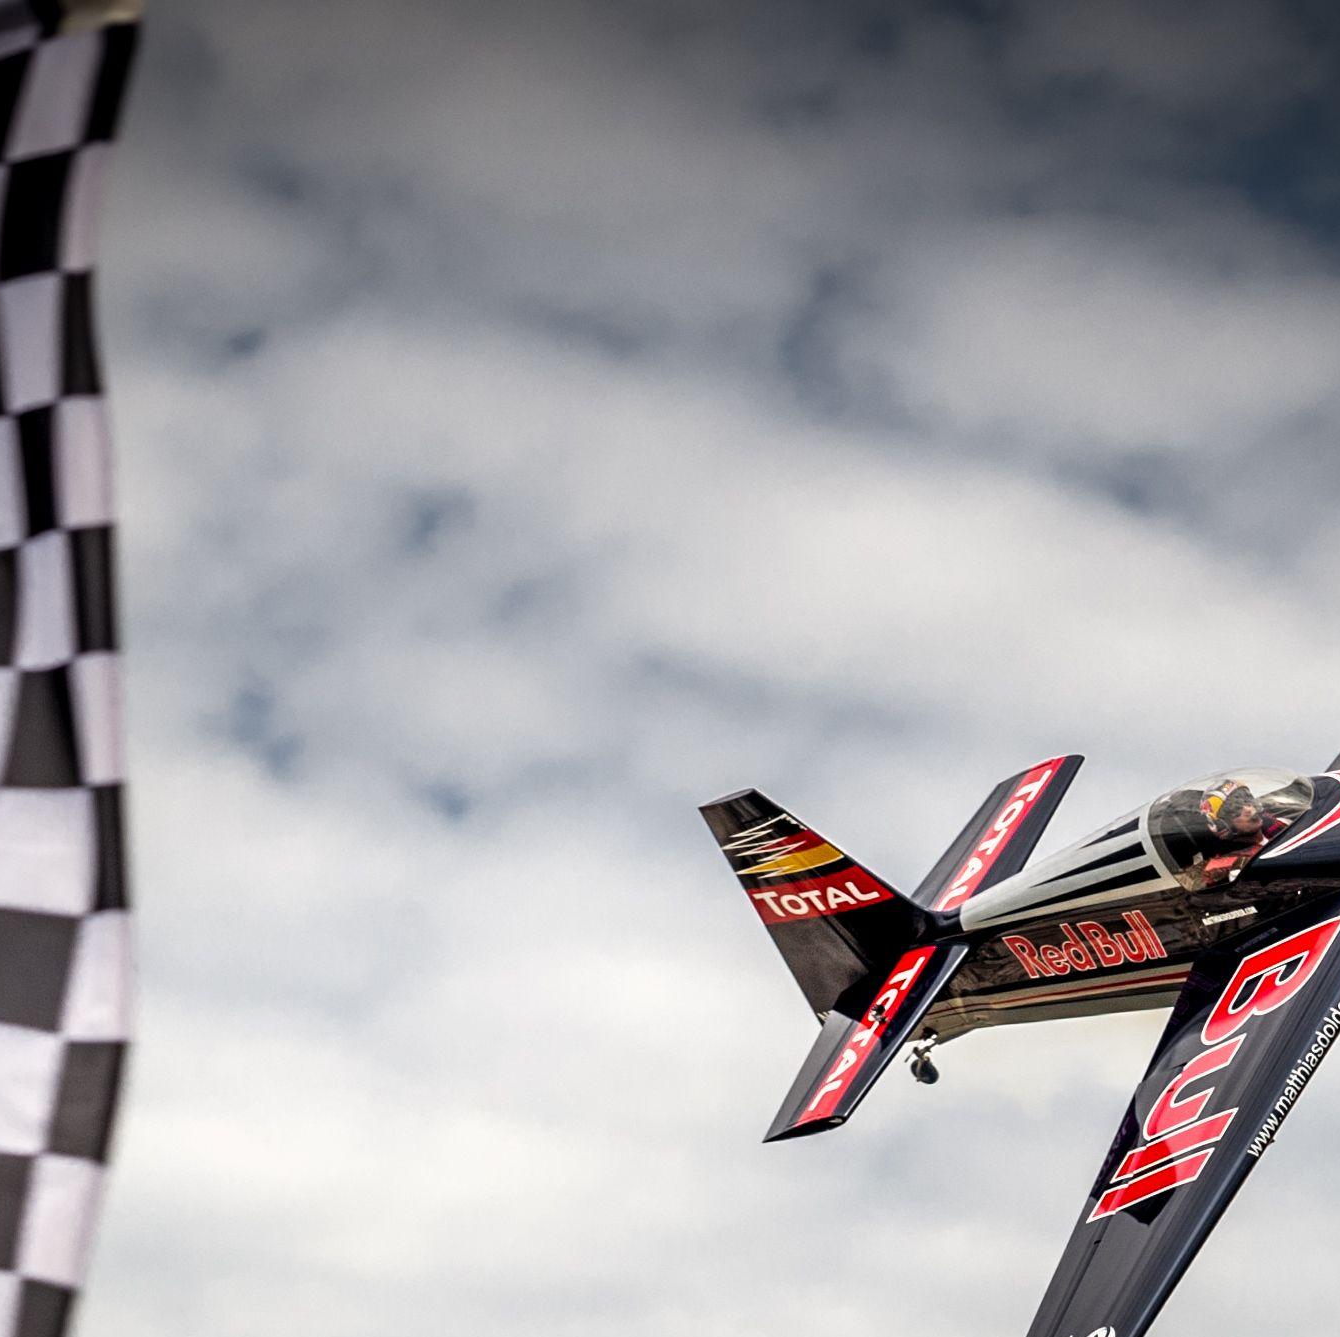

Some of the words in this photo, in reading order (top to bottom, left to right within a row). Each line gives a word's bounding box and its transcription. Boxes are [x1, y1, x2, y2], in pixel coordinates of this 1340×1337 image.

[937, 769, 1053, 911] TOTAL
[752, 881, 881, 918] TOTAL
[1002, 922, 1097, 978] Red
[1076, 910, 1168, 967] Bull
[808, 956, 926, 1112] TOTAL
